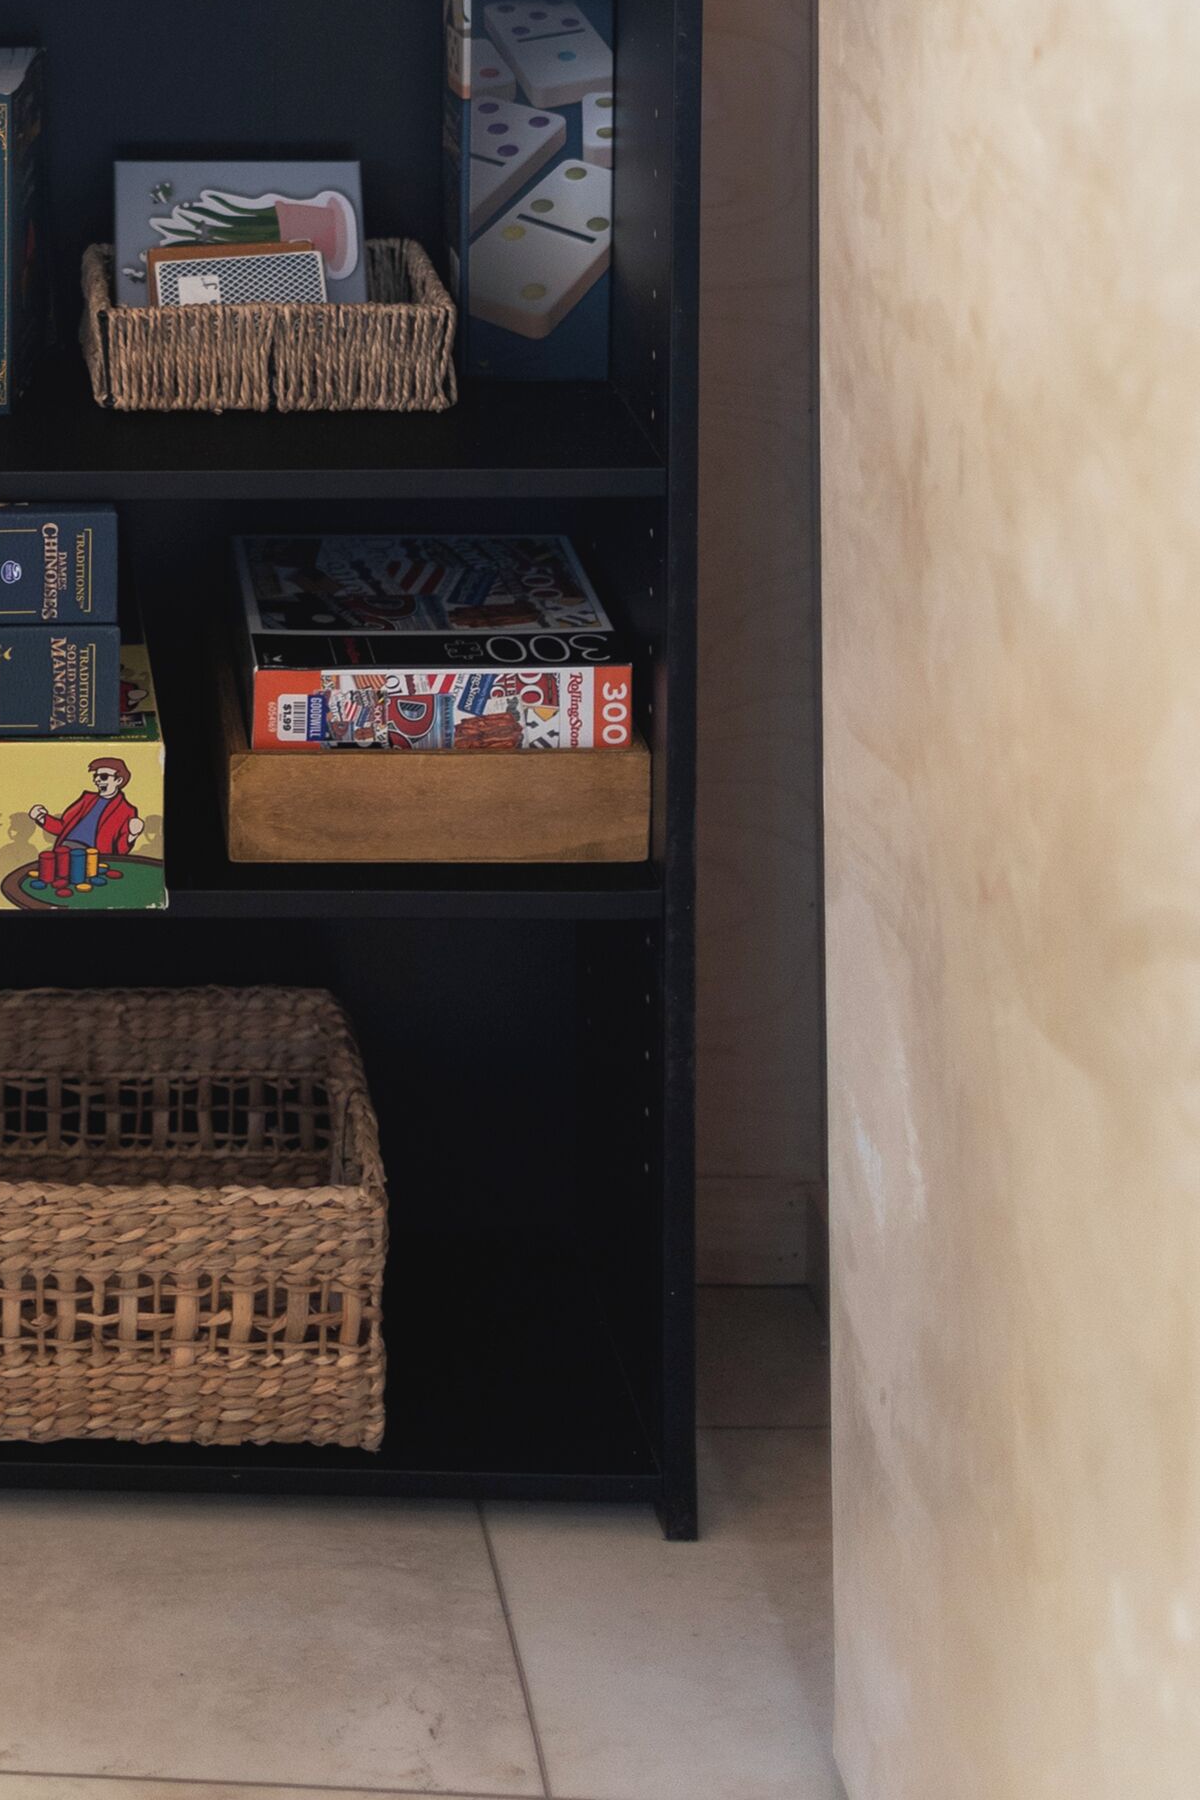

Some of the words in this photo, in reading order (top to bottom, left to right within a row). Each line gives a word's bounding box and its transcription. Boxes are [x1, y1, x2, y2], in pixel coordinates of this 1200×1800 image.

[41, 522, 59, 620] CHINOISES
[59, 551, 68, 591] DAMES
[75, 532, 86, 603] TRADITIONS
[49, 636, 67, 731] MANCALA
[66, 644, 77, 682] SOLID
[79, 647, 90, 724] TRADITIONS
[66, 684, 77, 723] WOOD
[282, 703, 292, 732] $1.99
[310, 697, 322, 738] GOODWILL
[601, 681, 628, 745] 300
